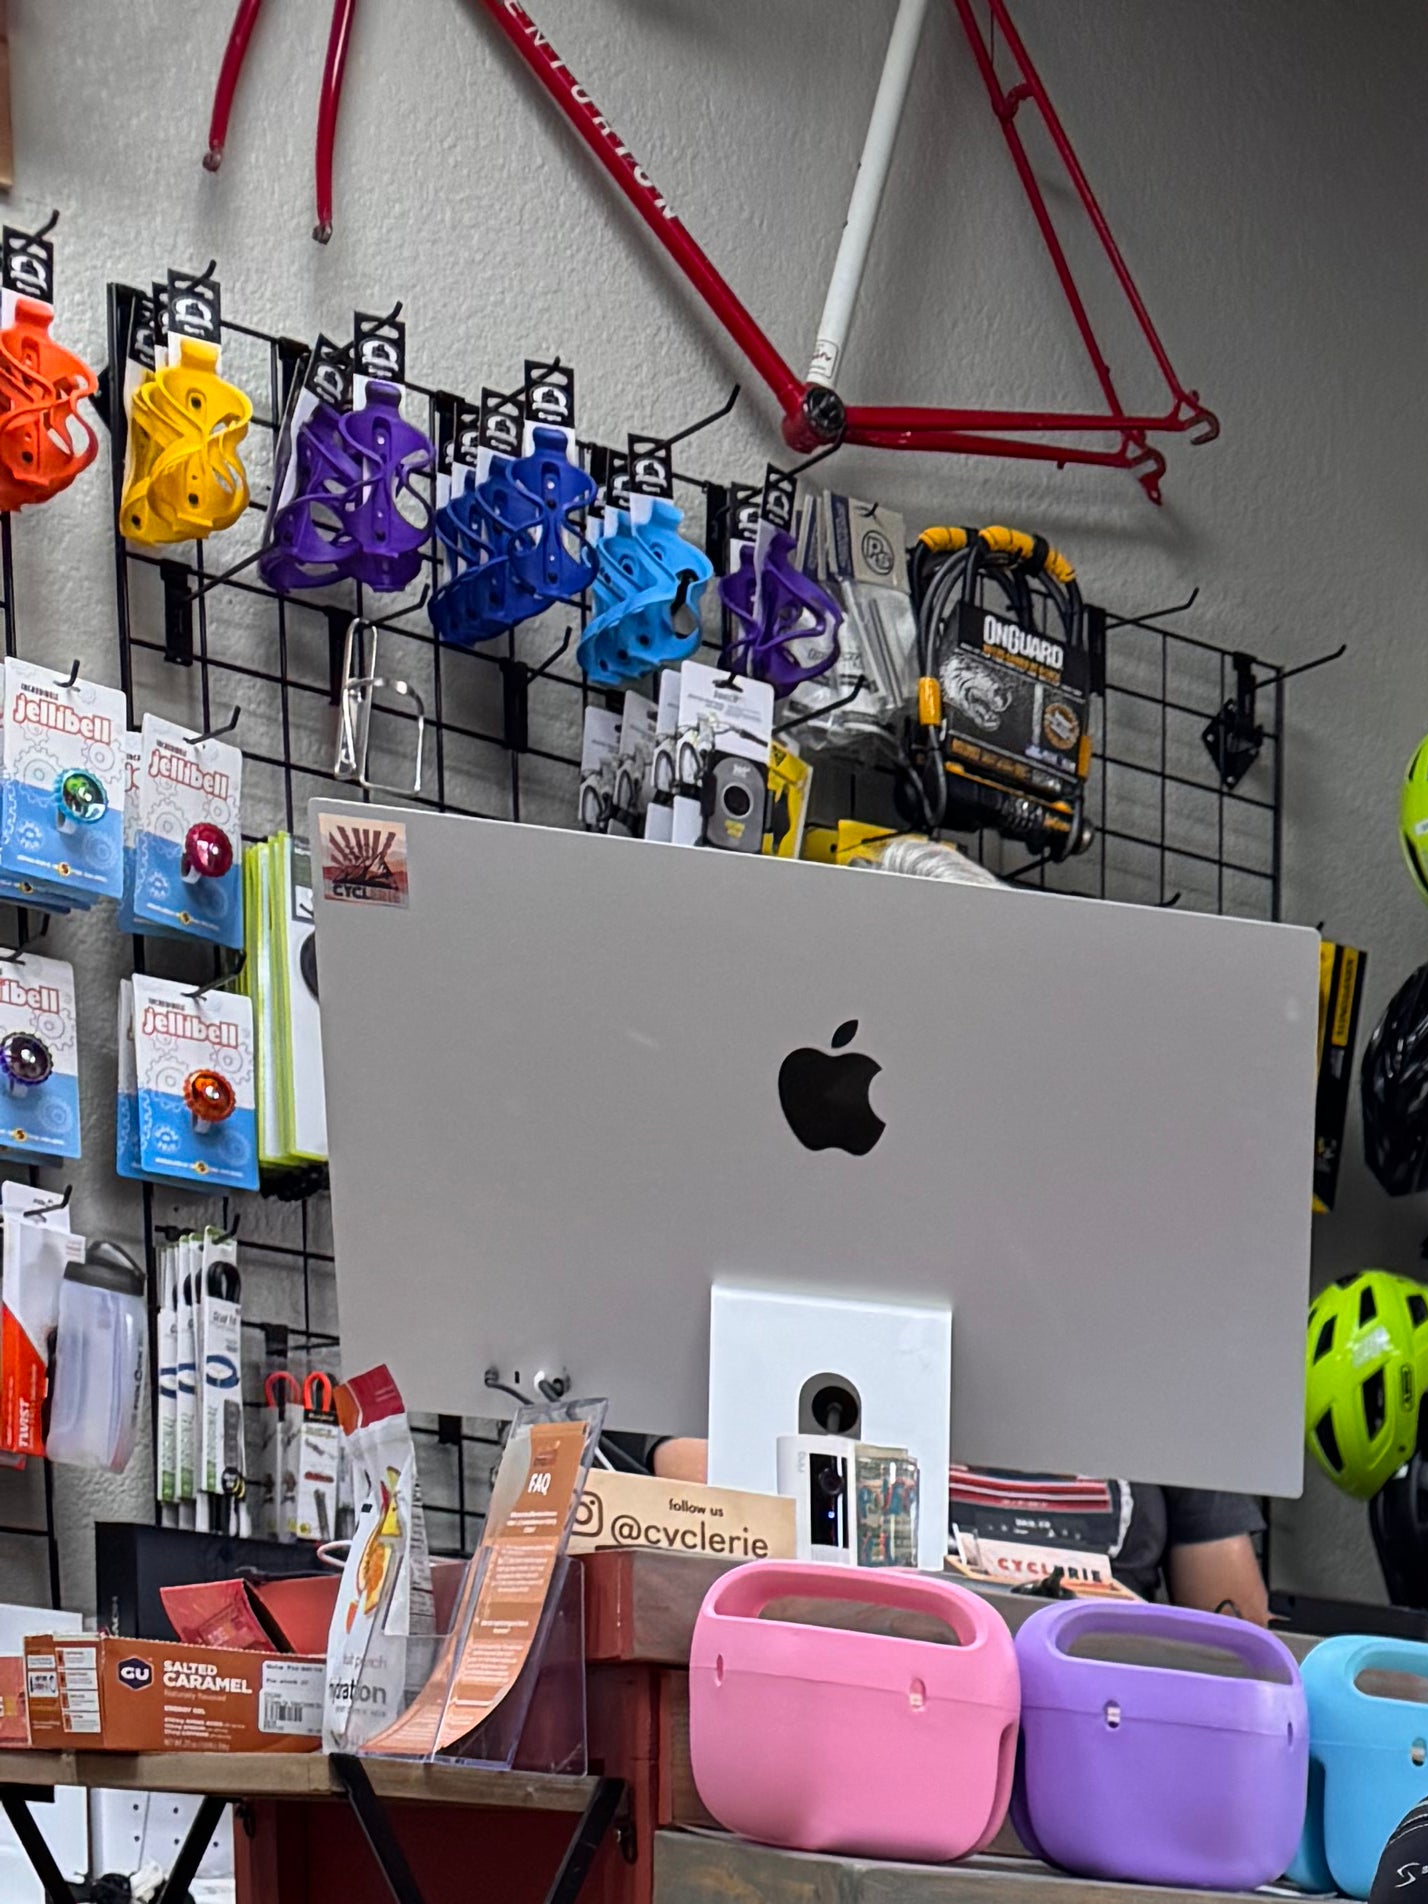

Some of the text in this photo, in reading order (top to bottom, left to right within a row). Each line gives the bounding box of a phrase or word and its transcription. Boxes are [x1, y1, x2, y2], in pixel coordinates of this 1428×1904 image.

[13, 693, 112, 746] jellibell
[148, 749, 230, 802] jellibell
[142, 1007, 239, 1050] jellibell
[18, 1398, 30, 1449] TWIST
[527, 1473, 552, 1497] FAQ
[668, 1498, 725, 1518] follow us
[997, 1555, 1103, 1583] CYCLRIE
[119, 1666, 150, 1682] GU
[163, 1659, 218, 1676] SALTED
[162, 1672, 253, 1694] CARAMEL
